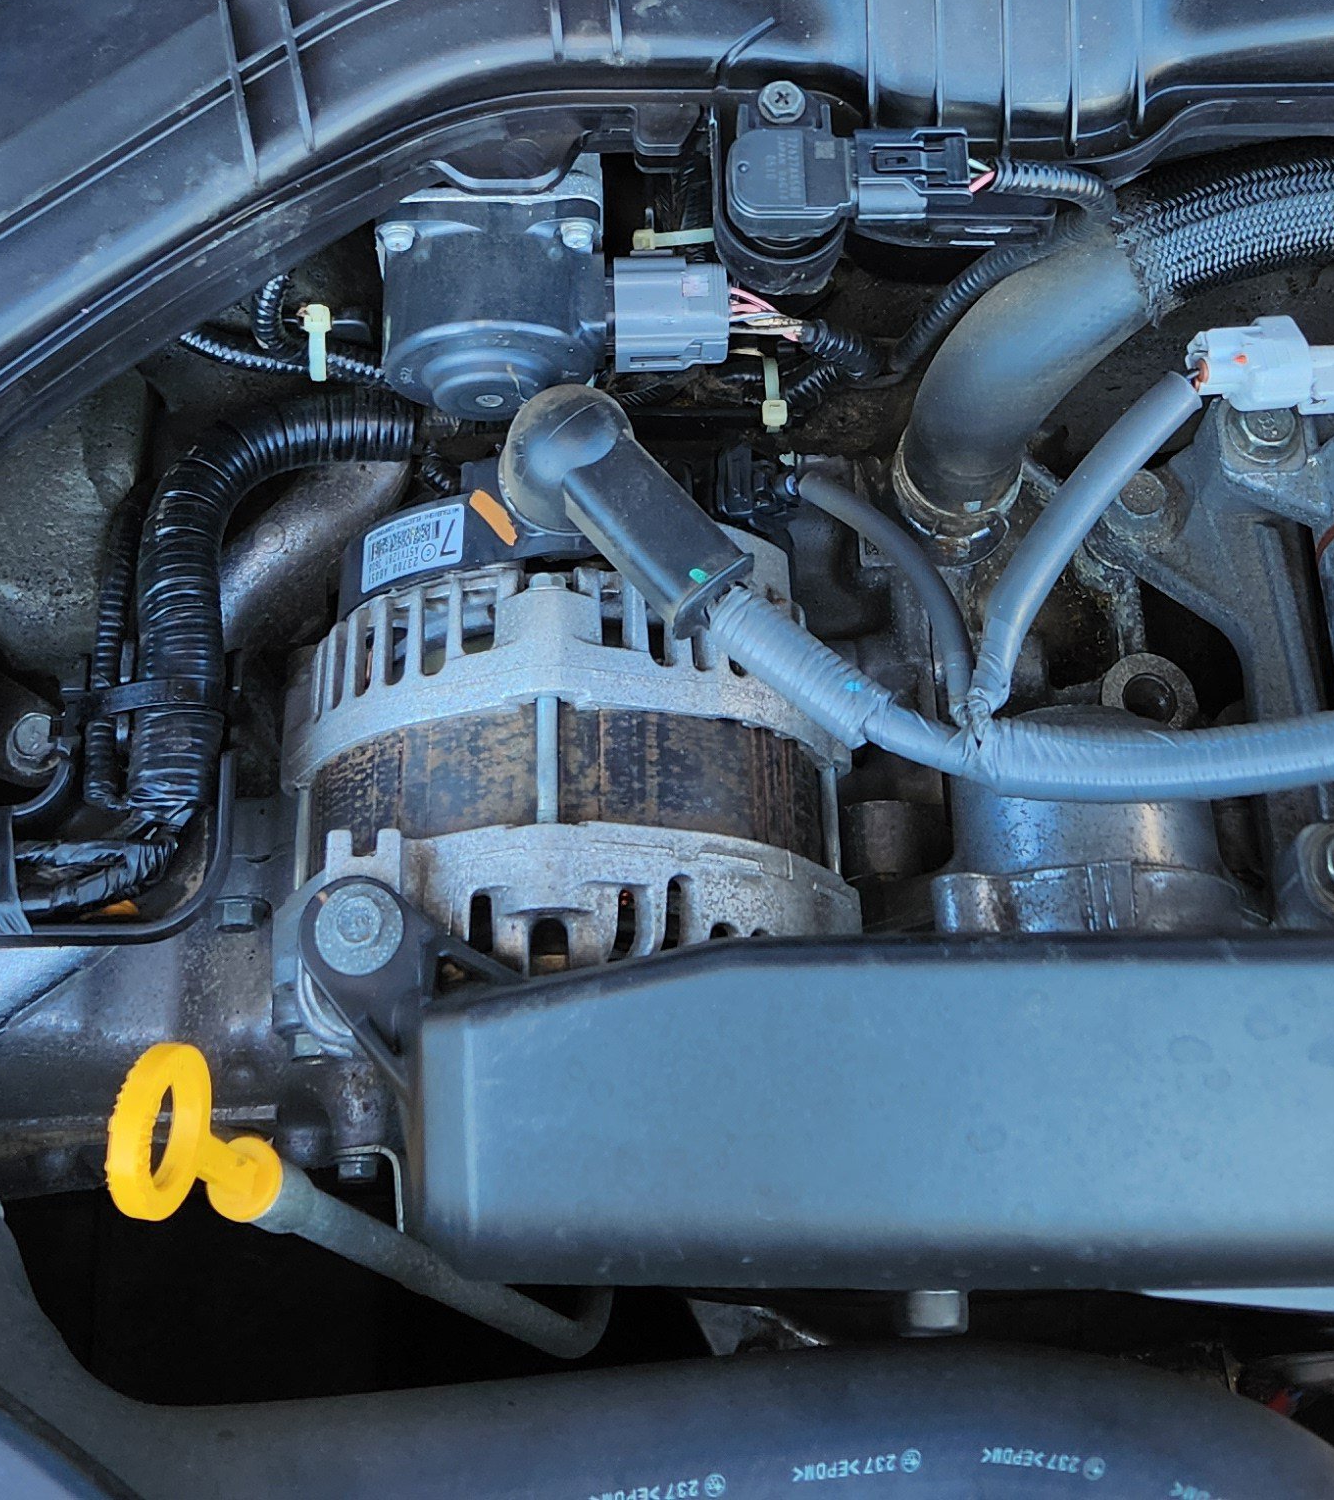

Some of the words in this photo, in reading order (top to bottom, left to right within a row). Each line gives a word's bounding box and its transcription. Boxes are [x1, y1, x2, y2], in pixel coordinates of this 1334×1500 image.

[439, 518, 457, 557] 7
[392, 558, 419, 574] 23700
[791, 1457, 861, 1484] >EPDM<
[863, 1453, 898, 1475] 237
[1044, 1453, 1082, 1475] 237
[665, 1478, 699, 1500] 237
